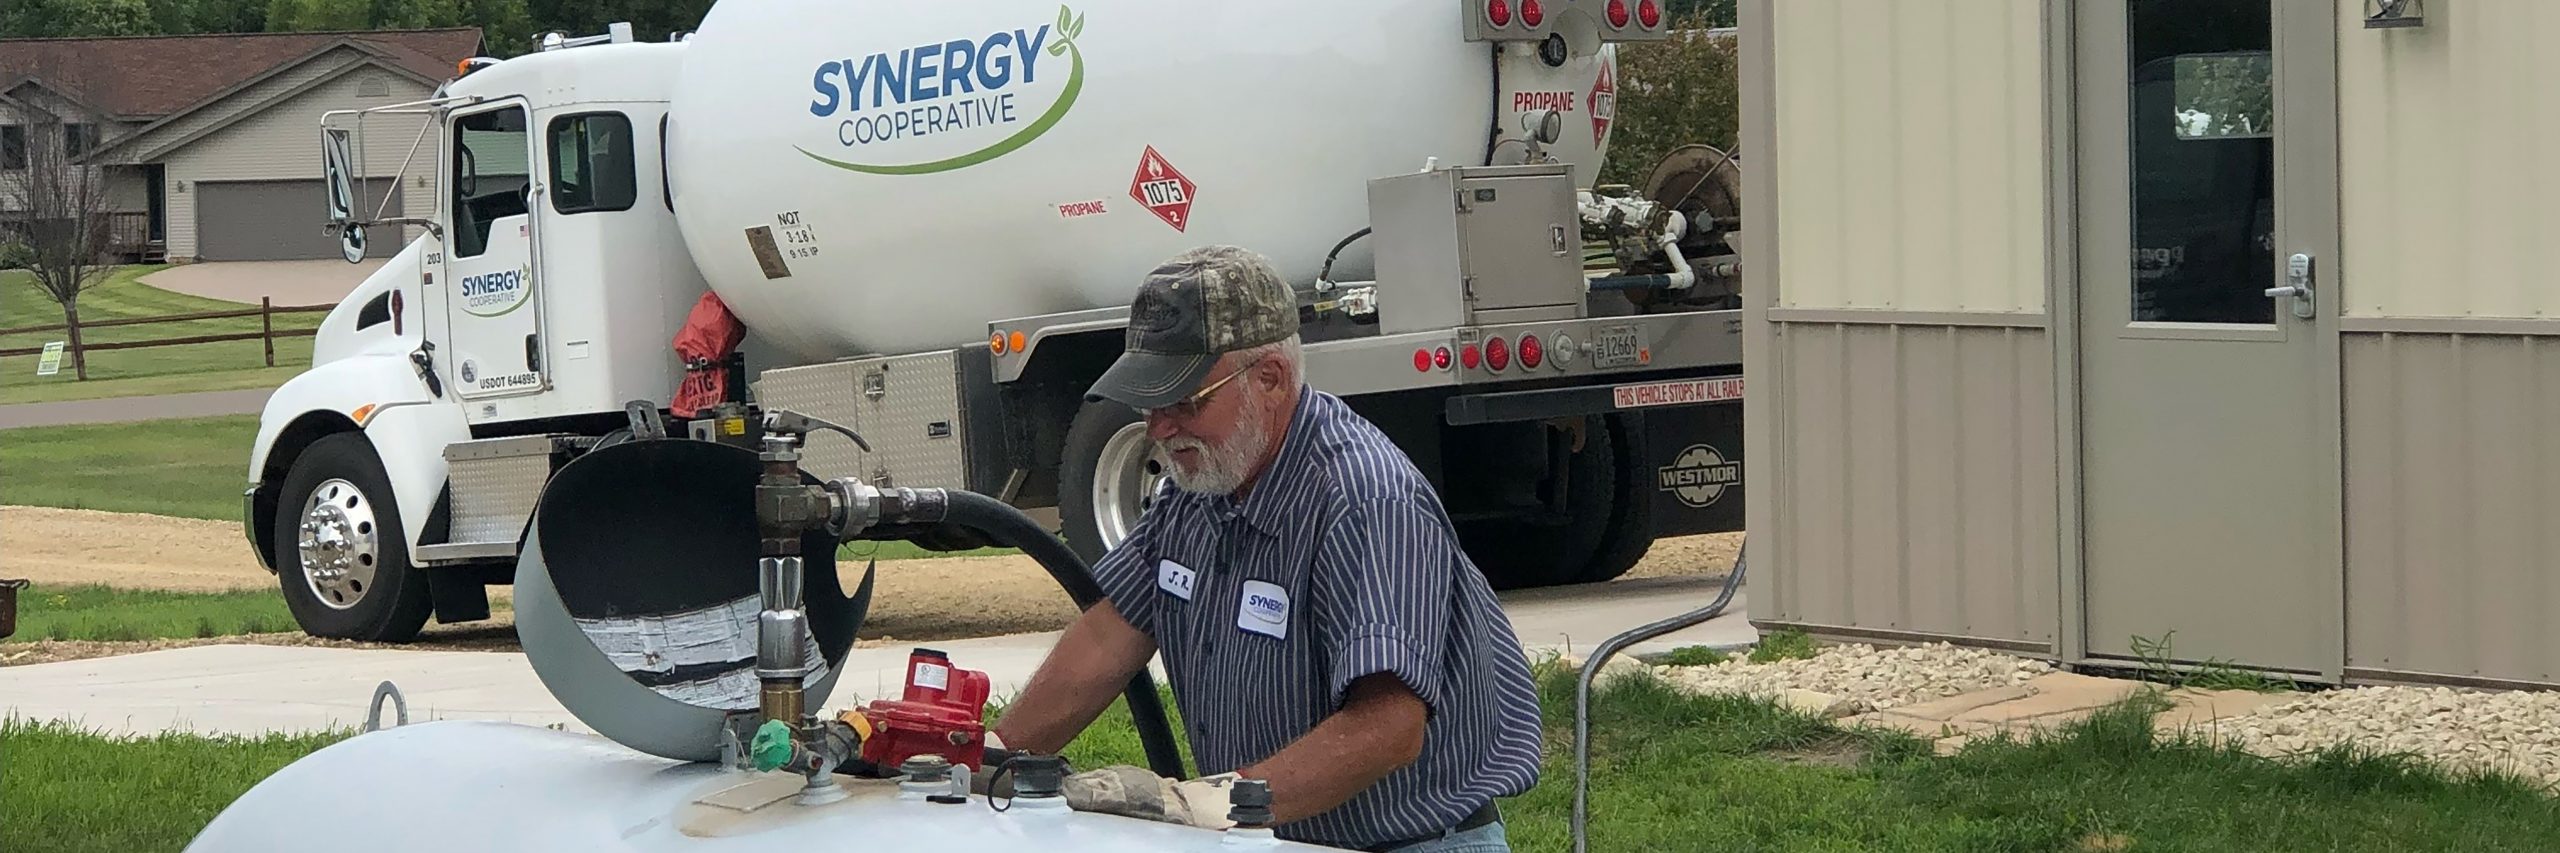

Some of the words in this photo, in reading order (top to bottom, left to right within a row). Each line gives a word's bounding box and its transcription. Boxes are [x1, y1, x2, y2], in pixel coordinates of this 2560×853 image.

[810, 24, 1050, 117] SYNERGY
[1514, 91, 1574, 112] PROPANE
[839, 93, 1016, 146] COOPERATIVE
[1144, 180, 1183, 205] 1075
[1059, 201, 1107, 218] PROPANE
[1169, 211, 1180, 222] 2
[427, 253, 441, 265] 203
[462, 269, 522, 296] SYNERGY
[469, 291, 515, 308] COOPERATIVE
[1606, 335, 1637, 357] 12669
[480, 376, 506, 389] USDOT
[1616, 388, 1634, 406] THIS
[1635, 385, 1668, 405] VEHICLE
[1669, 382, 1694, 402] STOPS
[1696, 382, 1705, 400] AT
[1707, 381, 1721, 399] ALL
[1662, 466, 1737, 486] WESTMOR
